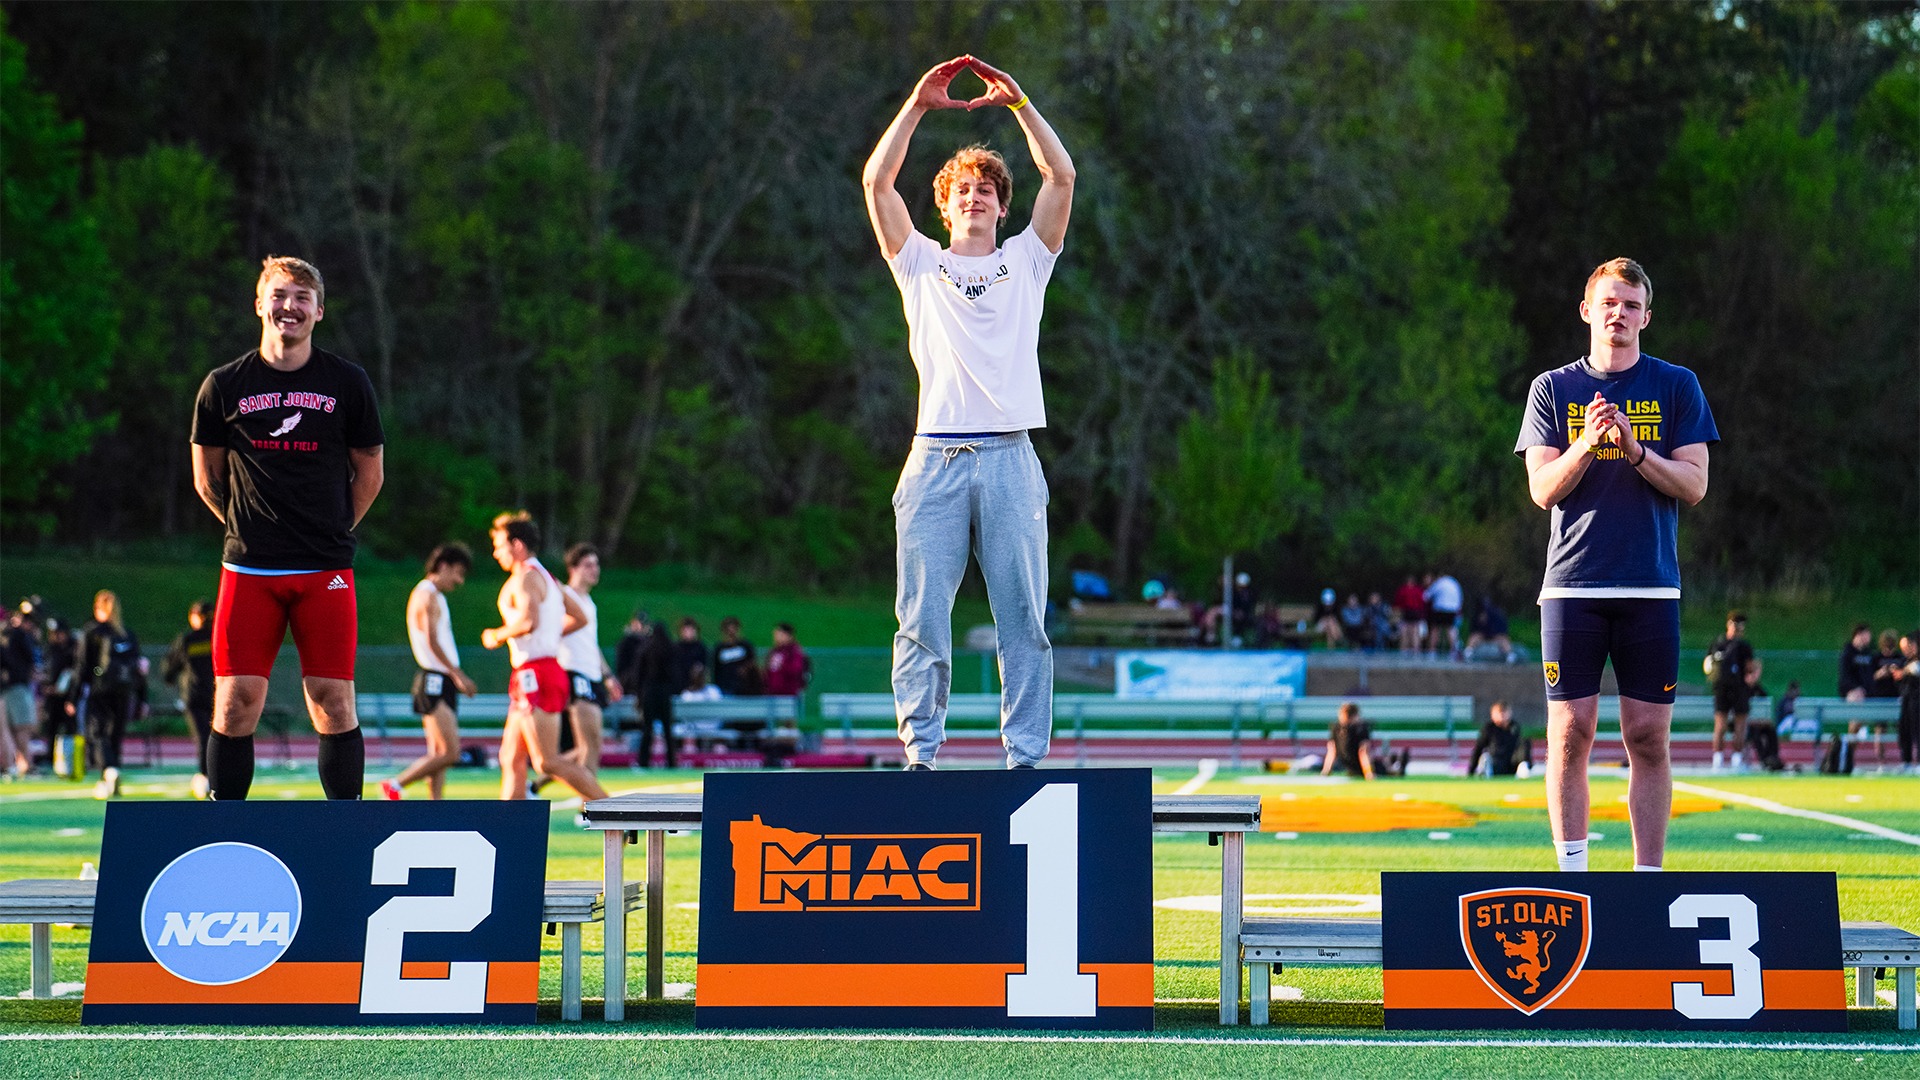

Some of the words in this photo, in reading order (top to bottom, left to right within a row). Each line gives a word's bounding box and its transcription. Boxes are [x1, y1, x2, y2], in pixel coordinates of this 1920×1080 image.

[239, 393, 282, 414] SAINT
[283, 392, 337, 413] JOHN'S
[251, 440, 280, 449] TRACK
[283, 440, 290, 450] &
[294, 441, 318, 451] FIELD
[763, 844, 969, 900] MIAC
[359, 830, 497, 1014] 2
[1006, 783, 1097, 1017] 1
[1476, 903, 1509, 928] ST.
[1513, 902, 1573, 927] OLAF
[157, 912, 290, 946] NCAA
[1668, 894, 1764, 1020] 3
